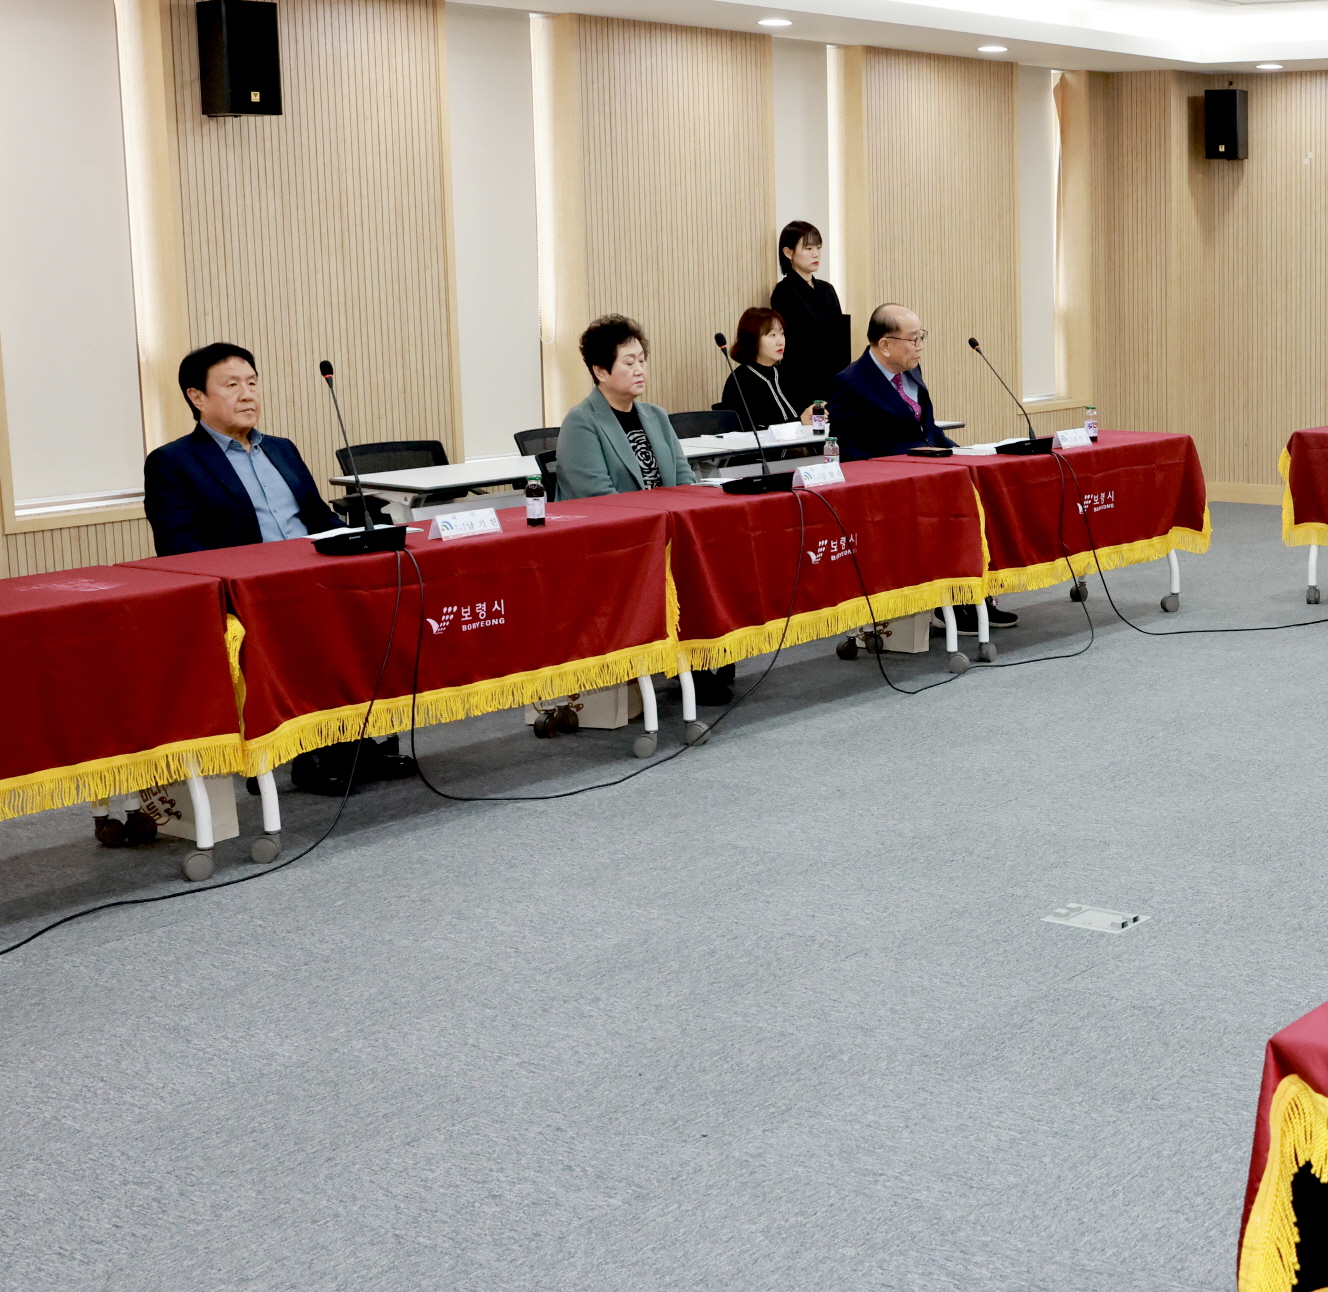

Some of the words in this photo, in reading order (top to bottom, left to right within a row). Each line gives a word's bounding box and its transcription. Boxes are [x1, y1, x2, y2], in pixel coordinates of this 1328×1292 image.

[1093, 490, 1114, 505] 보령시
[830, 532, 858, 553] 보령시
[460, 599, 505, 621] 보령시
[461, 617, 505, 632] BORYEONG
